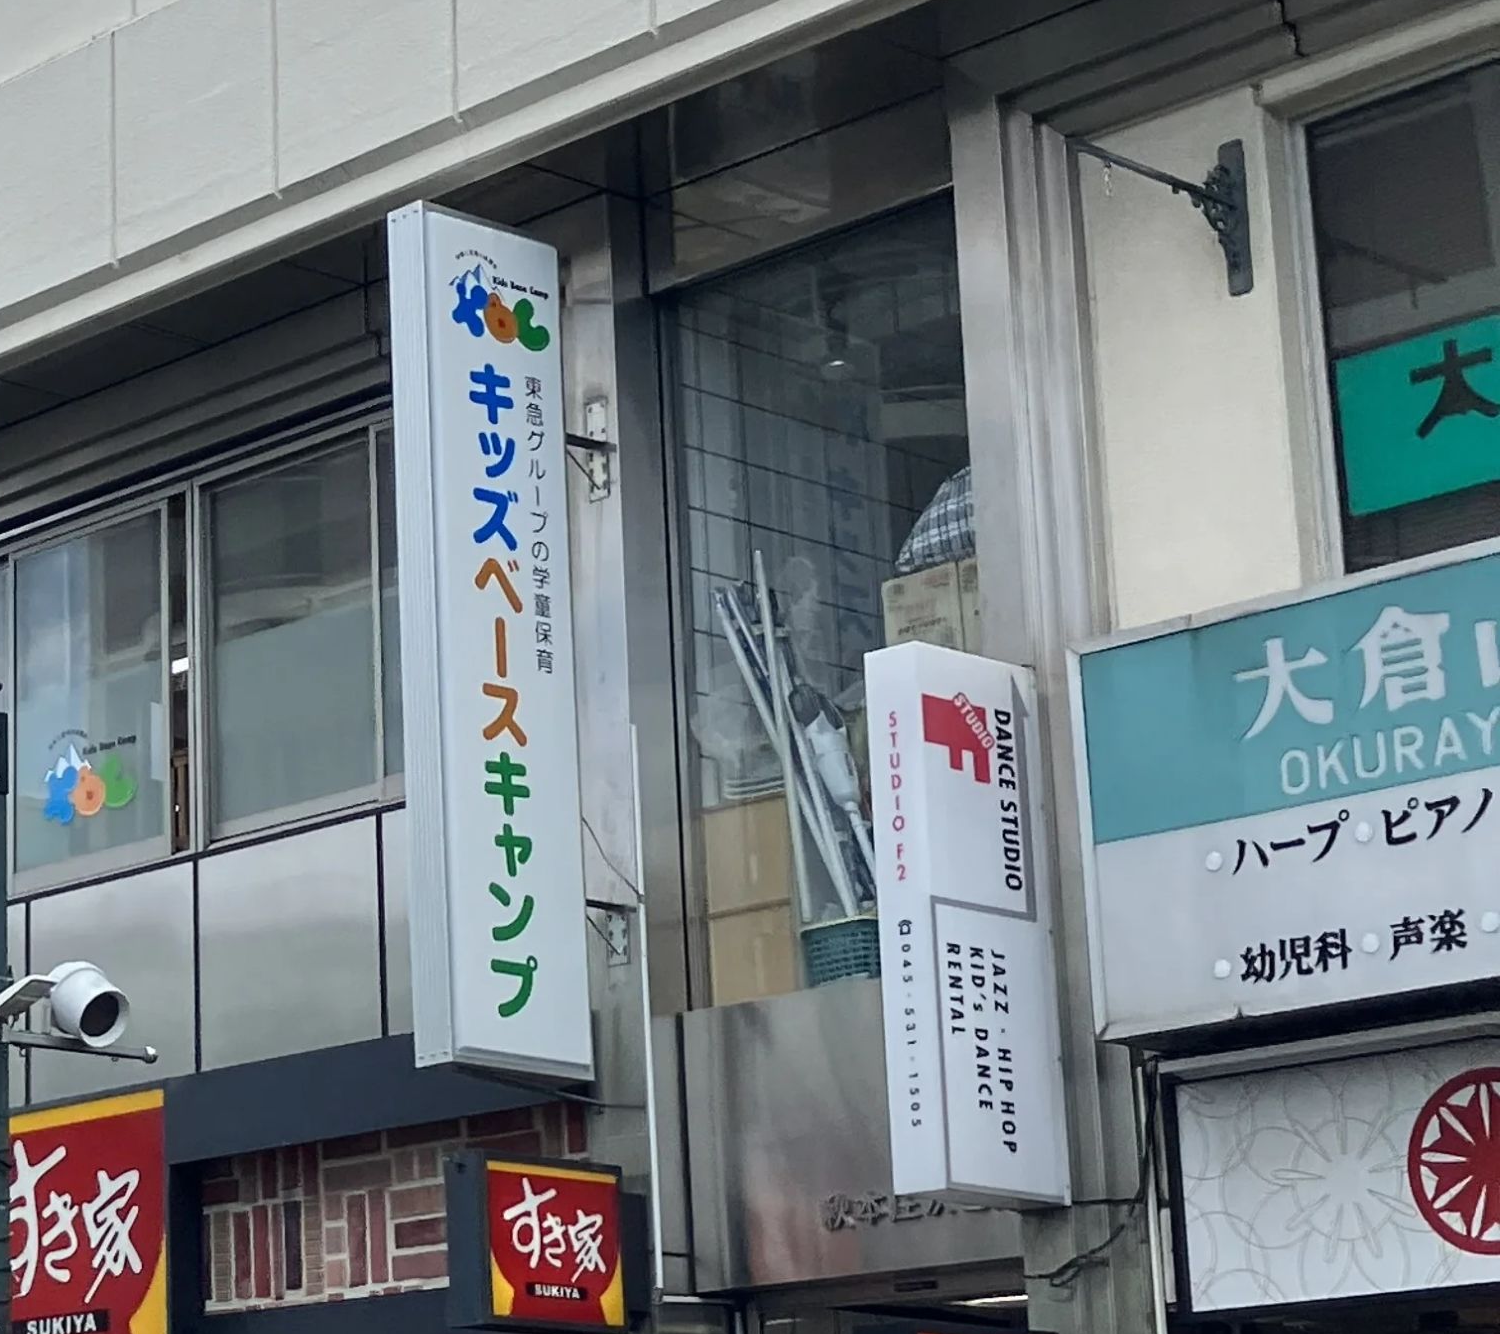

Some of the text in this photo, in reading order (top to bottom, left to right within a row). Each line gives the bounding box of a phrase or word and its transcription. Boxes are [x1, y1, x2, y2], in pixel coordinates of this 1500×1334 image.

[1409, 339, 1500, 440] 大
[523, 375, 553, 675] 東急グループの学童保育
[469, 363, 538, 1018] キッズベースキャンプ
[952, 692, 996, 751] STUDIO
[888, 710, 907, 881] STUDIO F2
[994, 708, 1023, 891] DANCE STUDIO
[1232, 787, 1494, 875] ハープ ピアノ
[946, 942, 966, 1035] RENTAL
[1240, 908, 1468, 984] 幼児科 声楽
[974, 1028, 994, 1111] DANCE
[990, 949, 1018, 1154] JAZZ HIP HOP
[503, 1177, 607, 1283] すき家
[534, 1283, 581, 1300] SUKIYA
